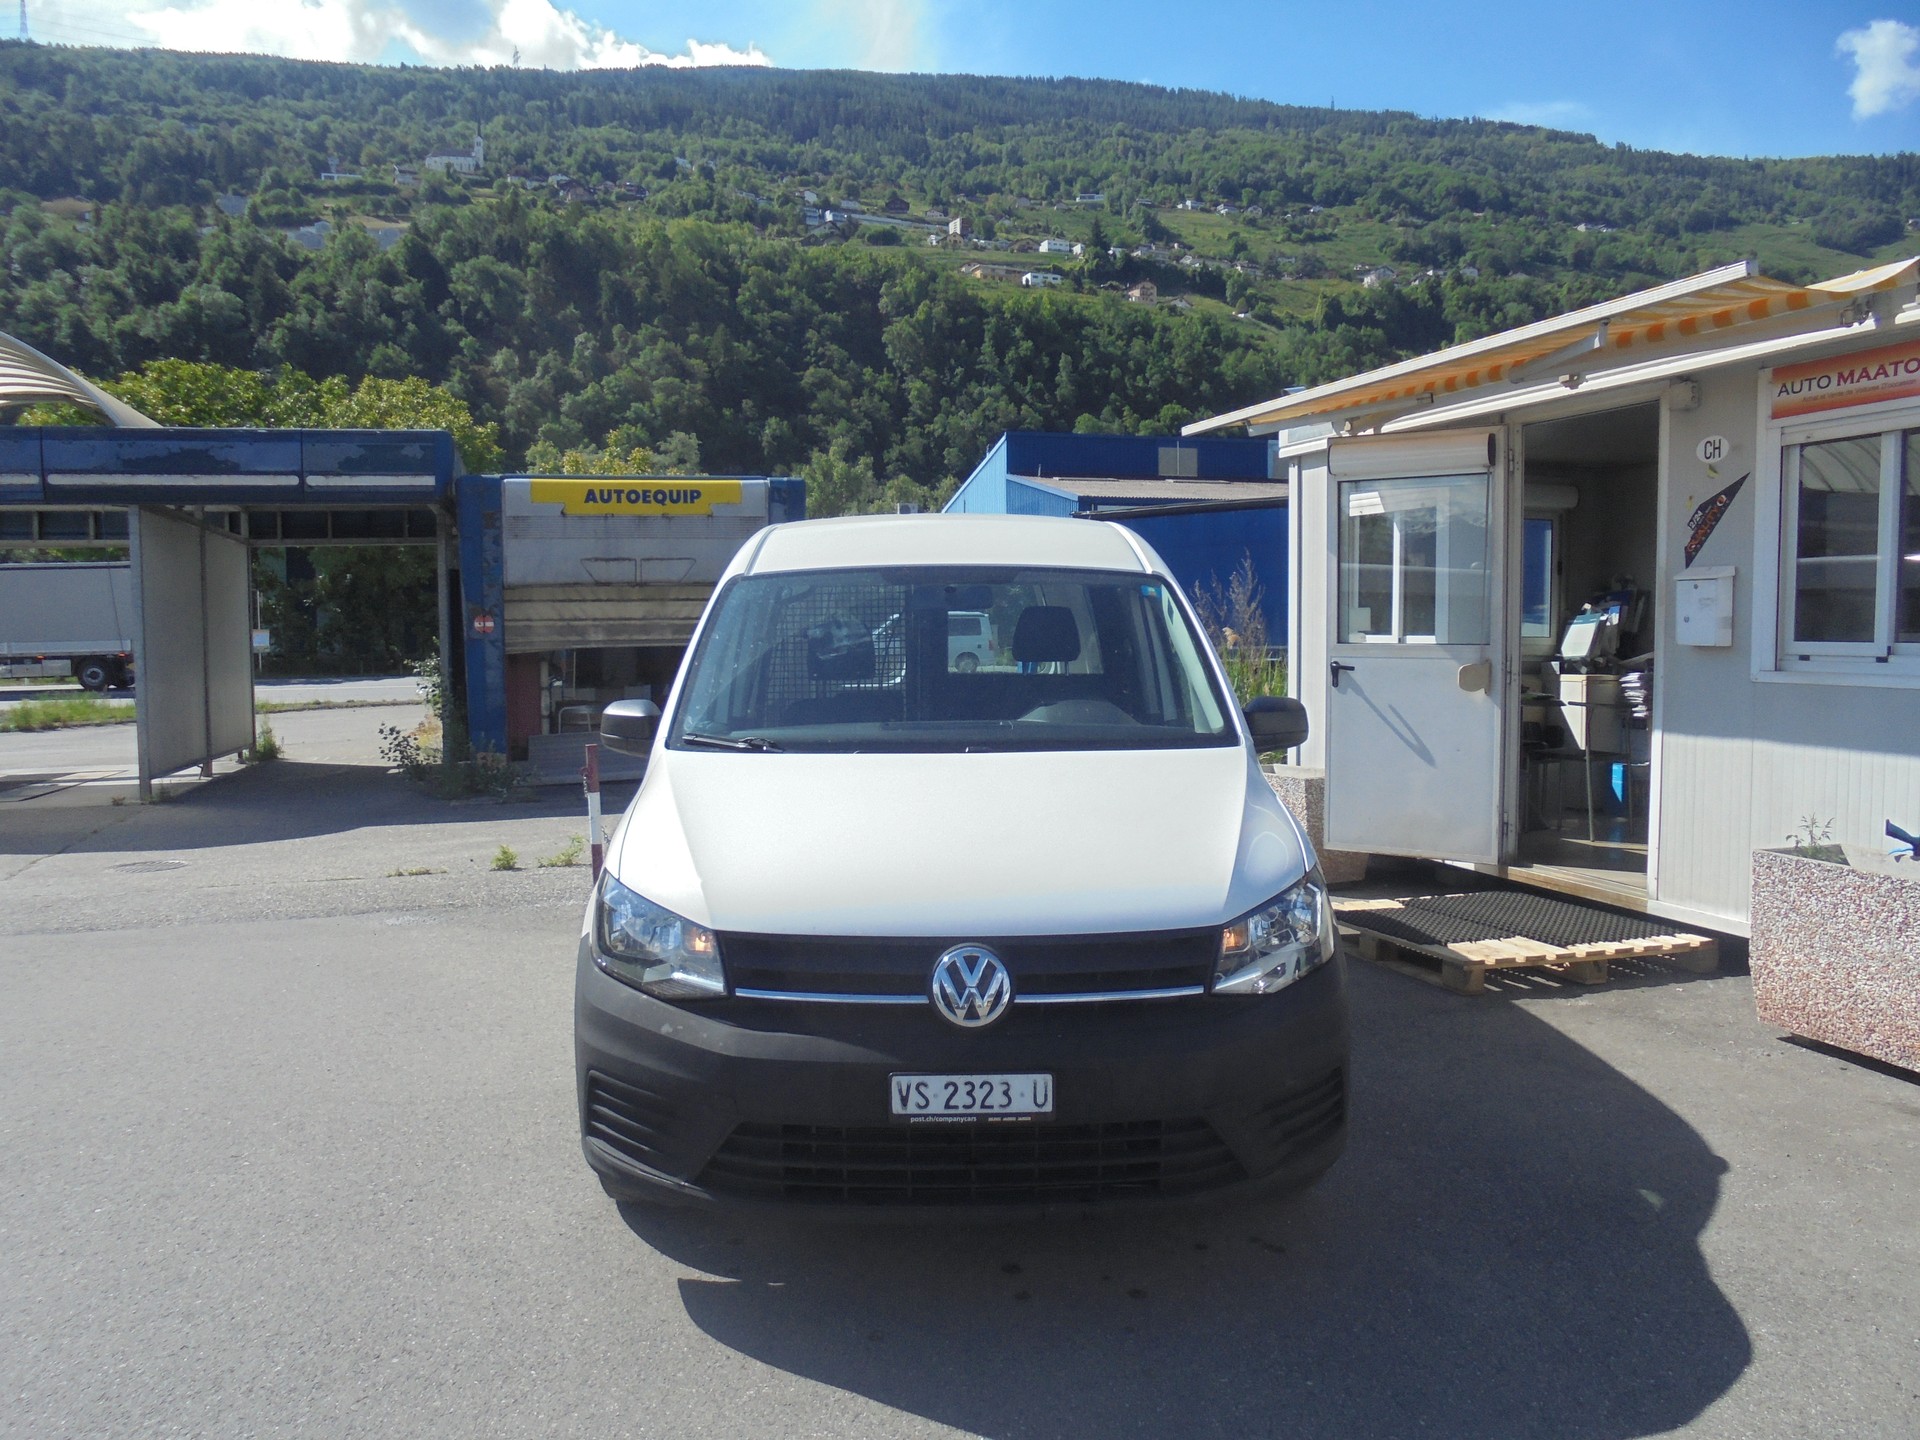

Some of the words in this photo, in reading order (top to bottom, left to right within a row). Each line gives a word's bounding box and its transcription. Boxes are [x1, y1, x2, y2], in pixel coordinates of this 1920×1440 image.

[1777, 375, 1833, 397] AUTO
[1704, 438, 1721, 460] CH
[584, 489, 702, 506] AUTOEQUIP
[897, 1080, 930, 1110] VS
[944, 1080, 1013, 1110] 2323
[1033, 1078, 1048, 1109] U
[910, 1115, 977, 1123] post.ch/companycars
